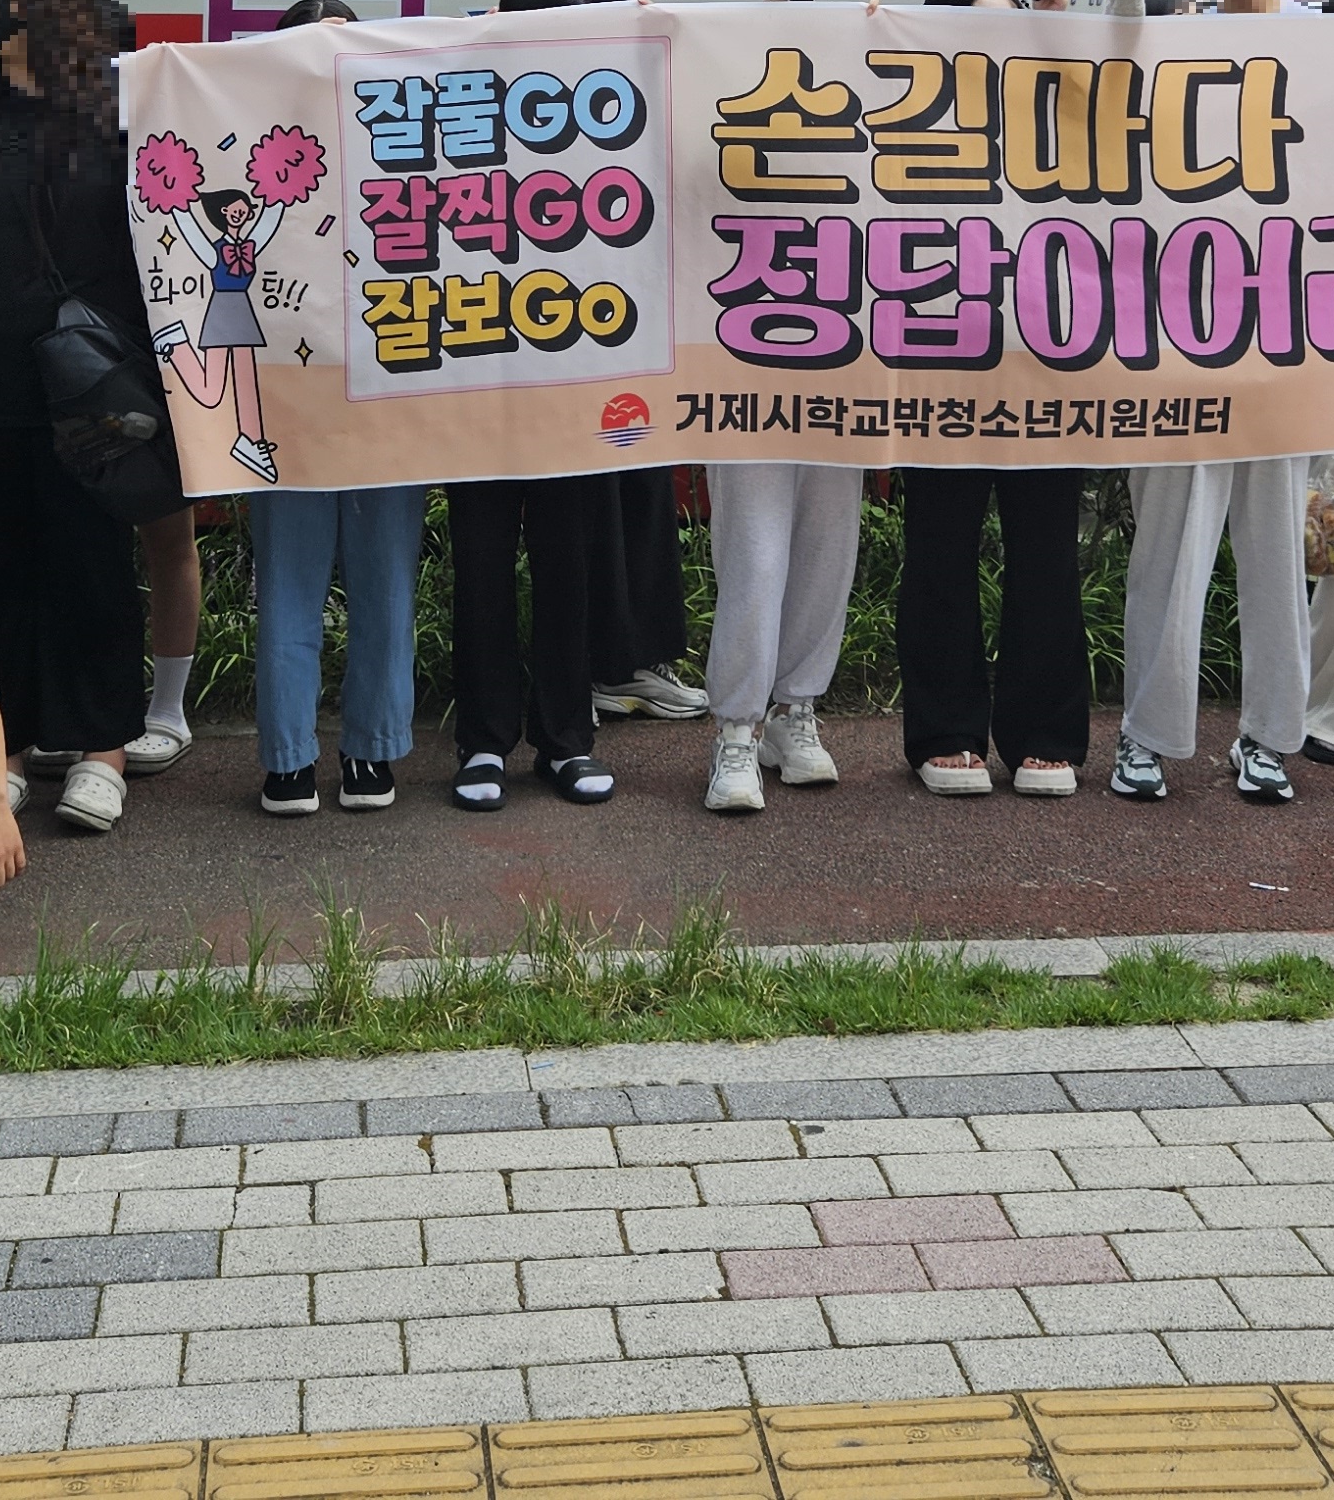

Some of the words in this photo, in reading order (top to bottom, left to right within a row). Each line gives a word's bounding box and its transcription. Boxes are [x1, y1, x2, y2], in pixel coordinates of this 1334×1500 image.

[355, 68, 647, 173] 잘풀GO
[710, 46, 1305, 205] 손길마다
[359, 165, 655, 274] 잘찍GO
[675, 392, 1233, 439] 거제시학교밖청소년지원센터
